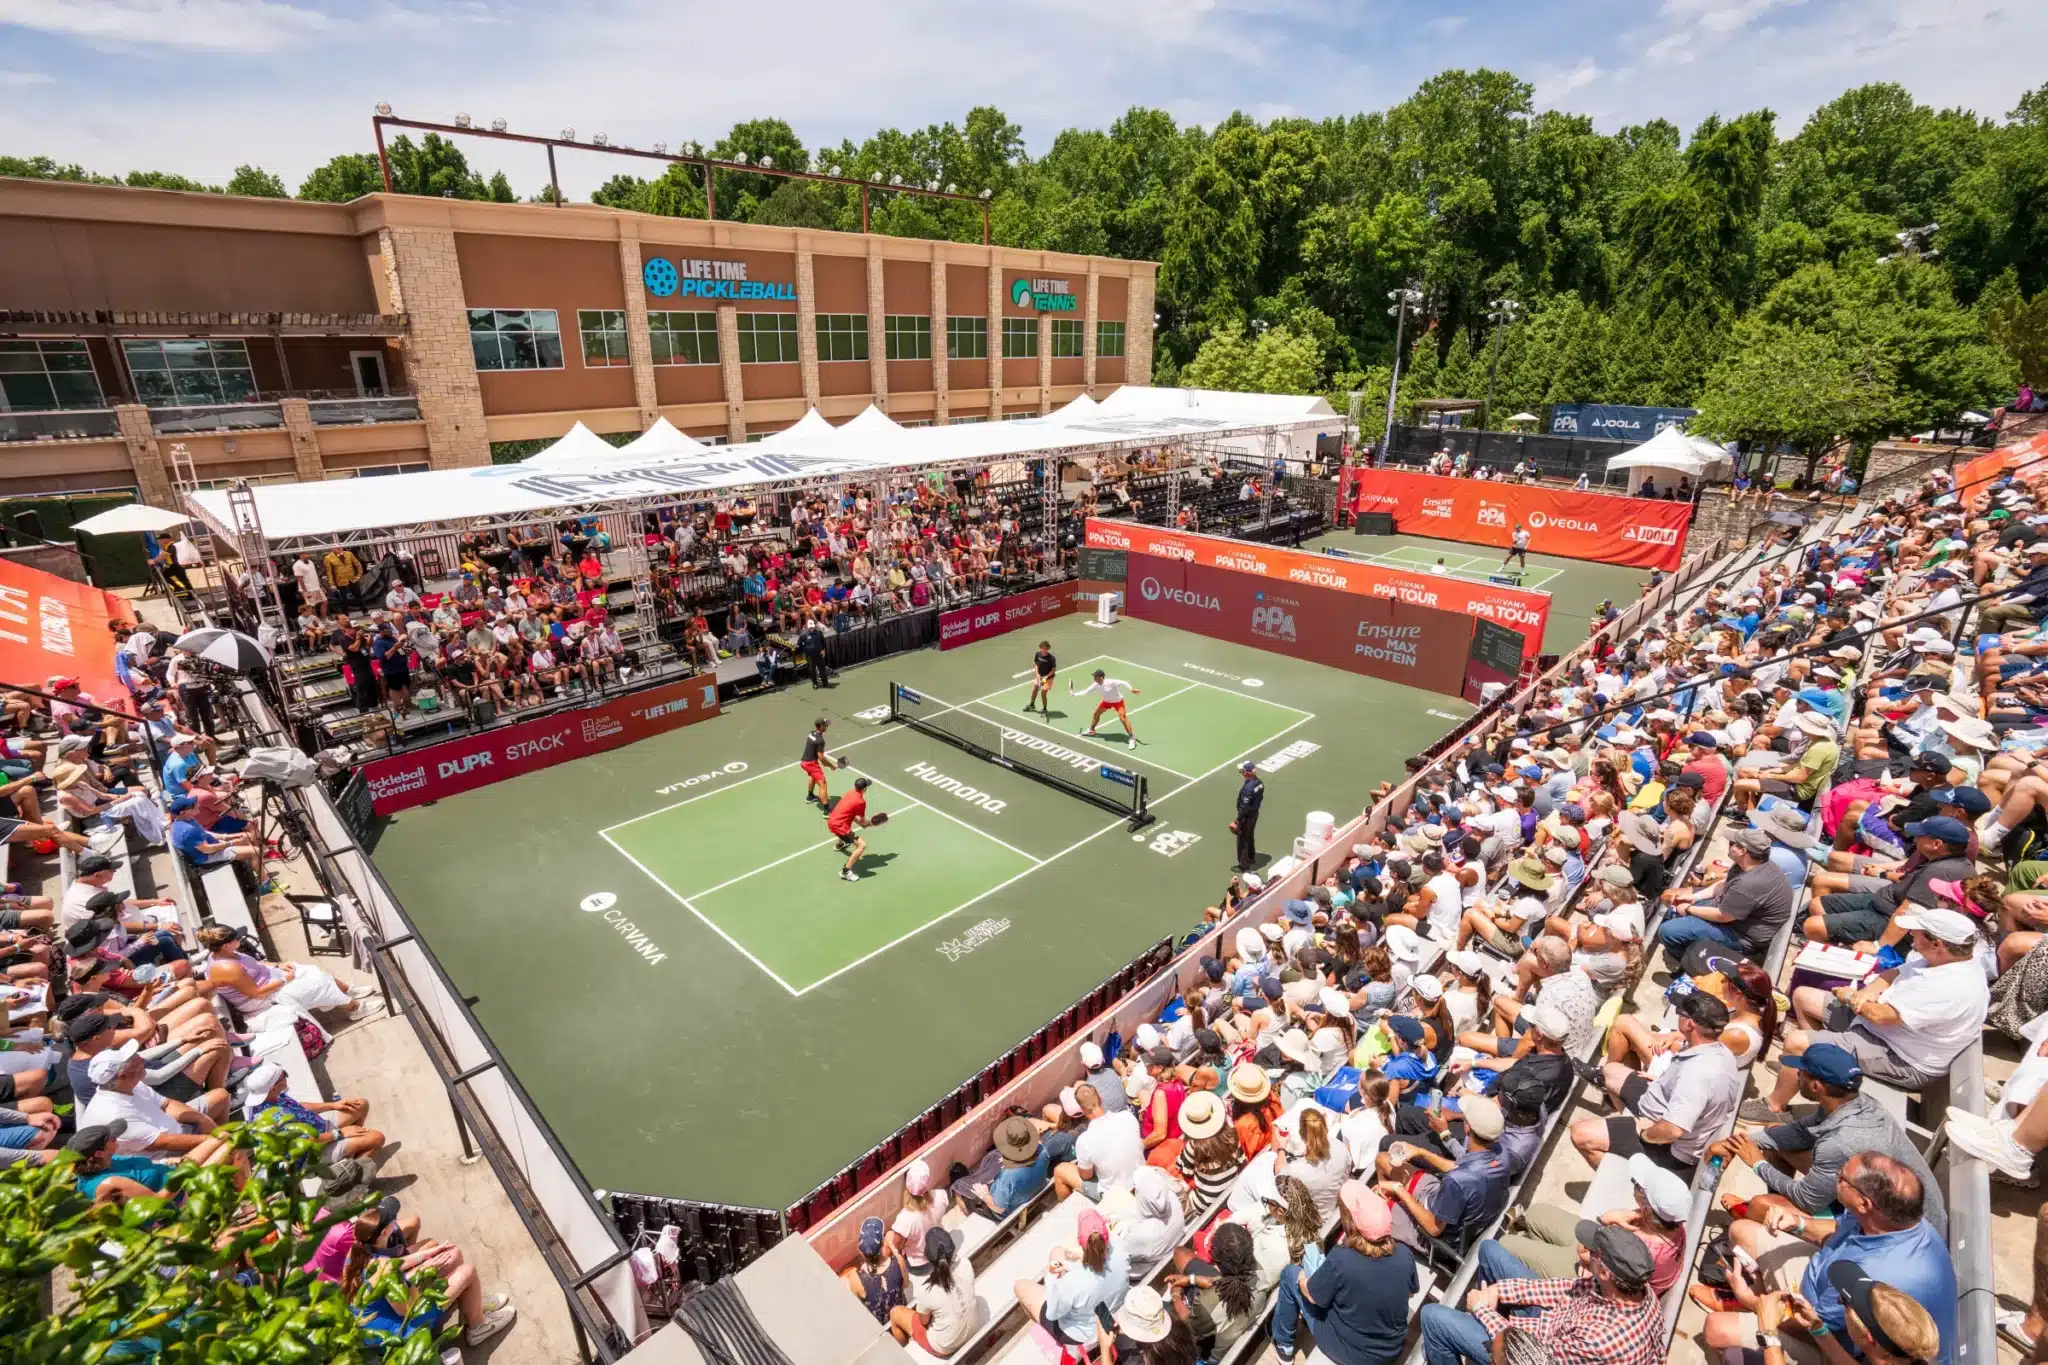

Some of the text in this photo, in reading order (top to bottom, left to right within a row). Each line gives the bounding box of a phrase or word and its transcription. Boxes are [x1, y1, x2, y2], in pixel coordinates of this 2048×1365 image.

[682, 259, 747, 281] LIFE TIME
[682, 280, 797, 301] PICKLEBALL
[1032, 279, 1069, 294] LIFE TIME
[1553, 416, 1578, 429] PPA
[1601, 420, 1641, 429] JOOLA
[1360, 493, 1399, 505] CARVANA
[1422, 498, 1454, 506] Ensure
[1421, 509, 1452, 518] PROTEIN
[1477, 508, 1506, 525] PPA
[1549, 517, 1598, 532] VEOLIA
[1088, 532, 1131, 548] PPA TOUR
[1639, 526, 1675, 544] JOOLA
[1149, 543, 1195, 562] PPA TOUR
[1215, 555, 1267, 573] PPA TOUR
[1304, 563, 1336, 575] CARVANA
[1289, 568, 1348, 589] PPA TOUR
[1388, 578, 1425, 591] CARVANA
[1163, 586, 1221, 611] VEOLIA
[1266, 595, 1300, 608] CARVANA
[1373, 583, 1438, 606] PPA TOUR
[1485, 596, 1526, 610] CARVANA
[974, 612, 1001, 628] DUPR
[1005, 604, 1033, 621] STACK
[1467, 601, 1540, 626] PPA TOUR
[943, 619, 970, 632] Pickleball
[1252, 607, 1296, 637] PPA
[1357, 620, 1421, 638] Ensure
[949, 626, 969, 639] Central
[1386, 638, 1418, 655] MAX
[1355, 643, 1417, 668] PROTEIN
[1183, 662, 1241, 681] CARVANA
[644, 704, 665, 720] LIFE
[665, 698, 689, 714] TIME
[595, 716, 611, 725] Just
[595, 720, 621, 732] Courts
[506, 732, 565, 761] STACK
[438, 750, 494, 779] DUPR
[655, 770, 725, 795] VEOLIA
[1109, 772, 1134, 785] CARVANA
[1149, 829, 1197, 856] PPA
[603, 909, 668, 966] CARVANA
